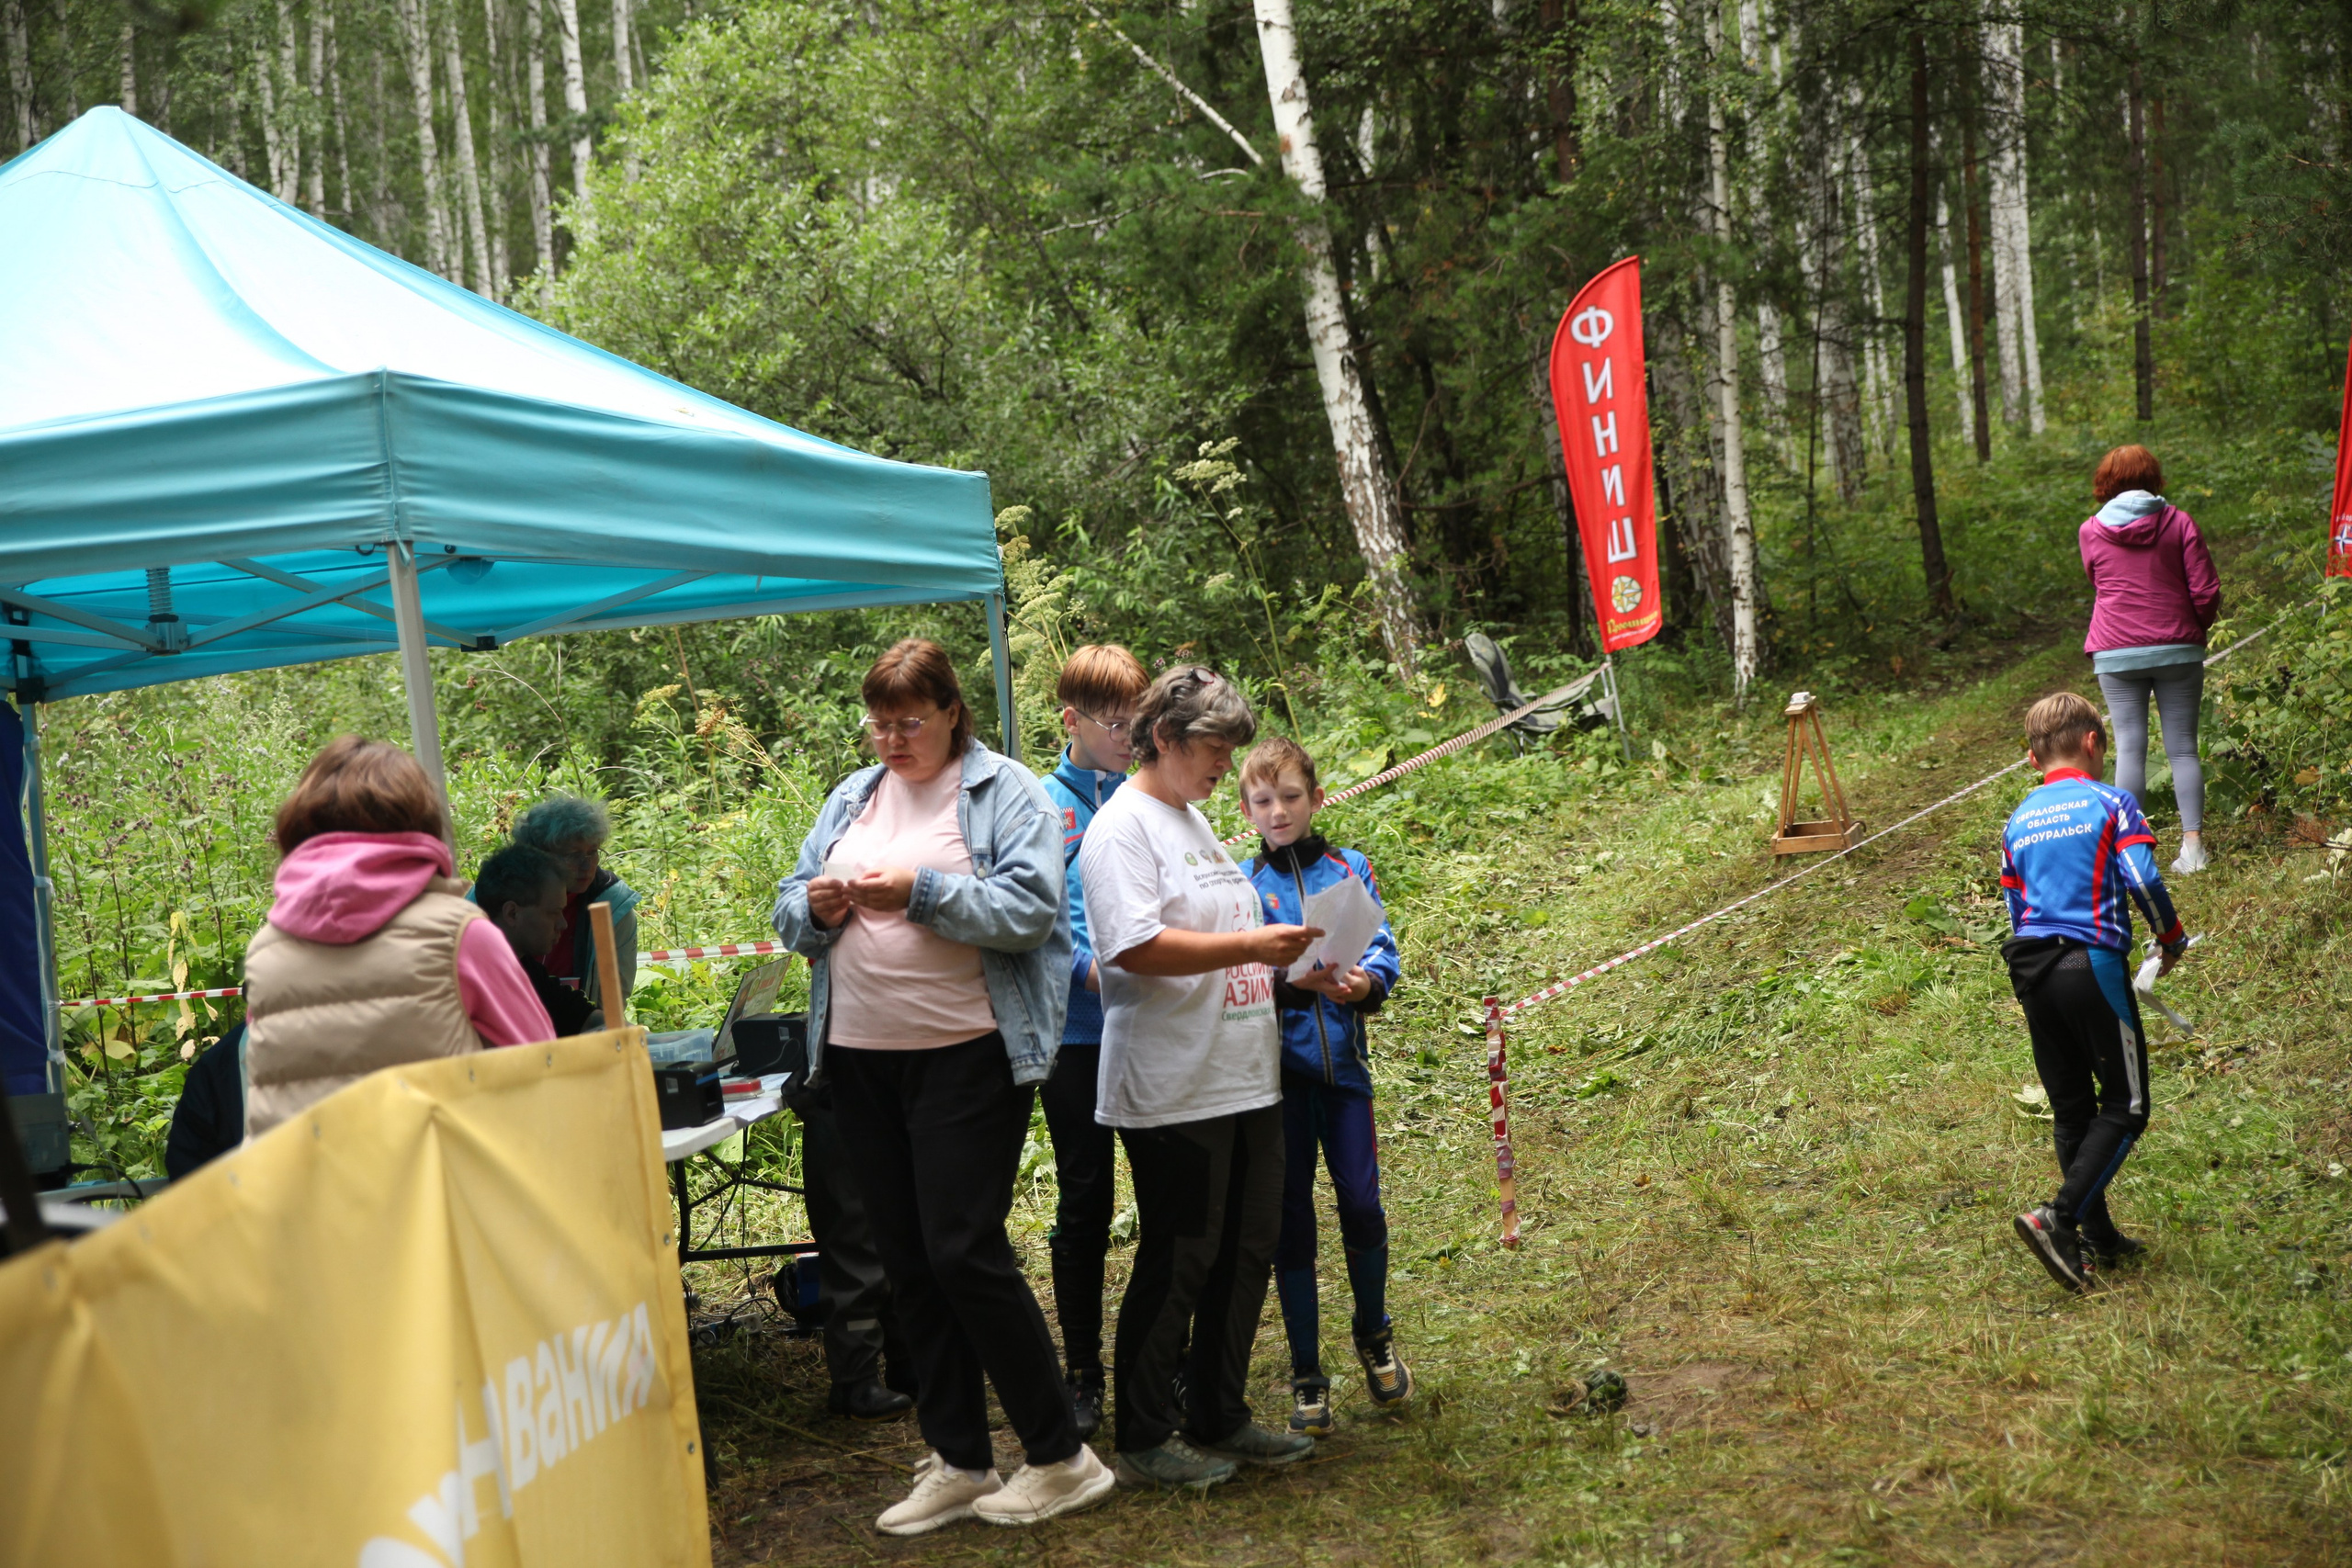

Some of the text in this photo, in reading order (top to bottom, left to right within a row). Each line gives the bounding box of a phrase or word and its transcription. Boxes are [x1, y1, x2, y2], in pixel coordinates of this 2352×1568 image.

[1570, 305, 1638, 565] ФИНИШ
[2015, 799, 2088, 825] СВЕРДЛОВСКАЯ
[2027, 813, 2071, 829] ОБЛАСТЬ
[2013, 823, 2093, 852] НОВОУРАЛЬСК
[1223, 976, 1274, 1009] АЗИМ
